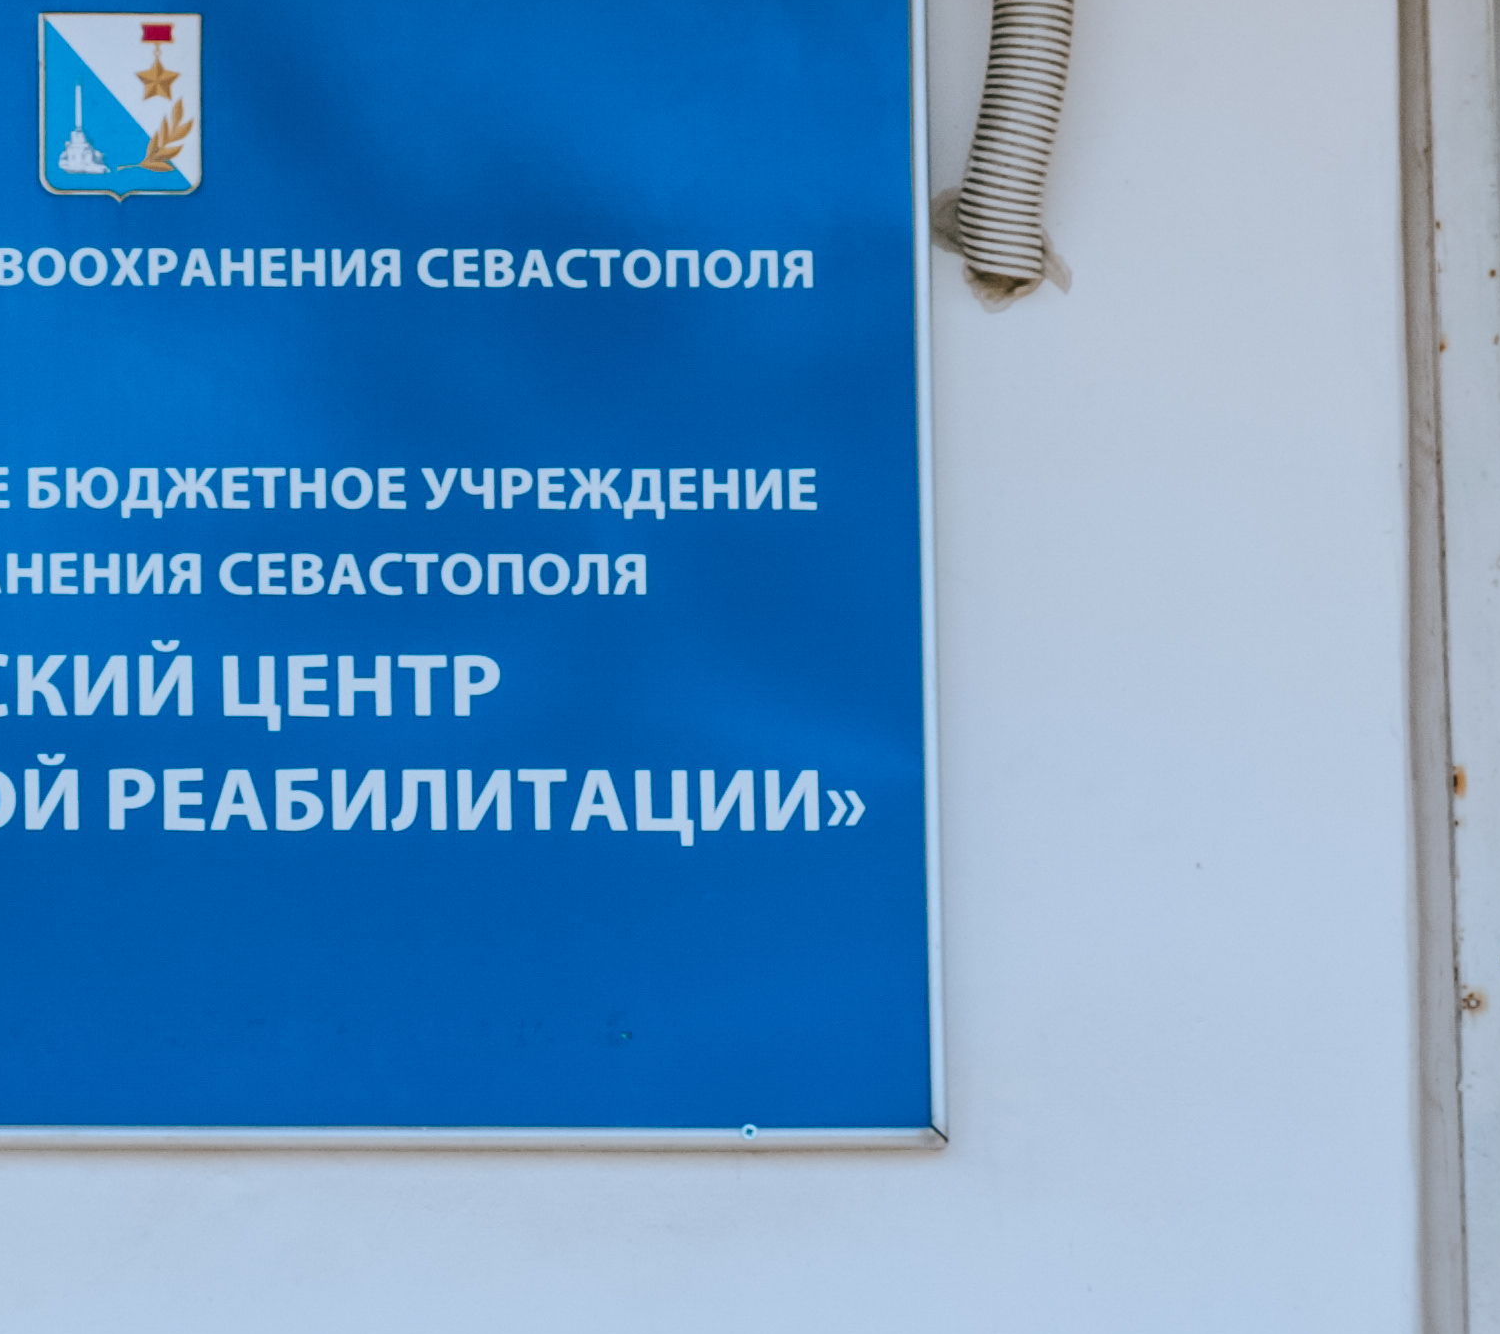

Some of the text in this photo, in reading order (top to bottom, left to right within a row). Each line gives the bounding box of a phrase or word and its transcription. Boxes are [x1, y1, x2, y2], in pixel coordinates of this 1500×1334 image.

[417, 247, 814, 289] СЕВАСТОПОЛЯ
[27, 466, 407, 519] БЮДЖЕТНОЕ
[421, 467, 818, 520] УЧРЕЖДЕНИЕ
[218, 552, 647, 596] СЕВАСТОПОЛЯ
[222, 654, 501, 732] ЦЕНТР
[108, 767, 866, 847] РЕАБИЛИТАЦИИ»
